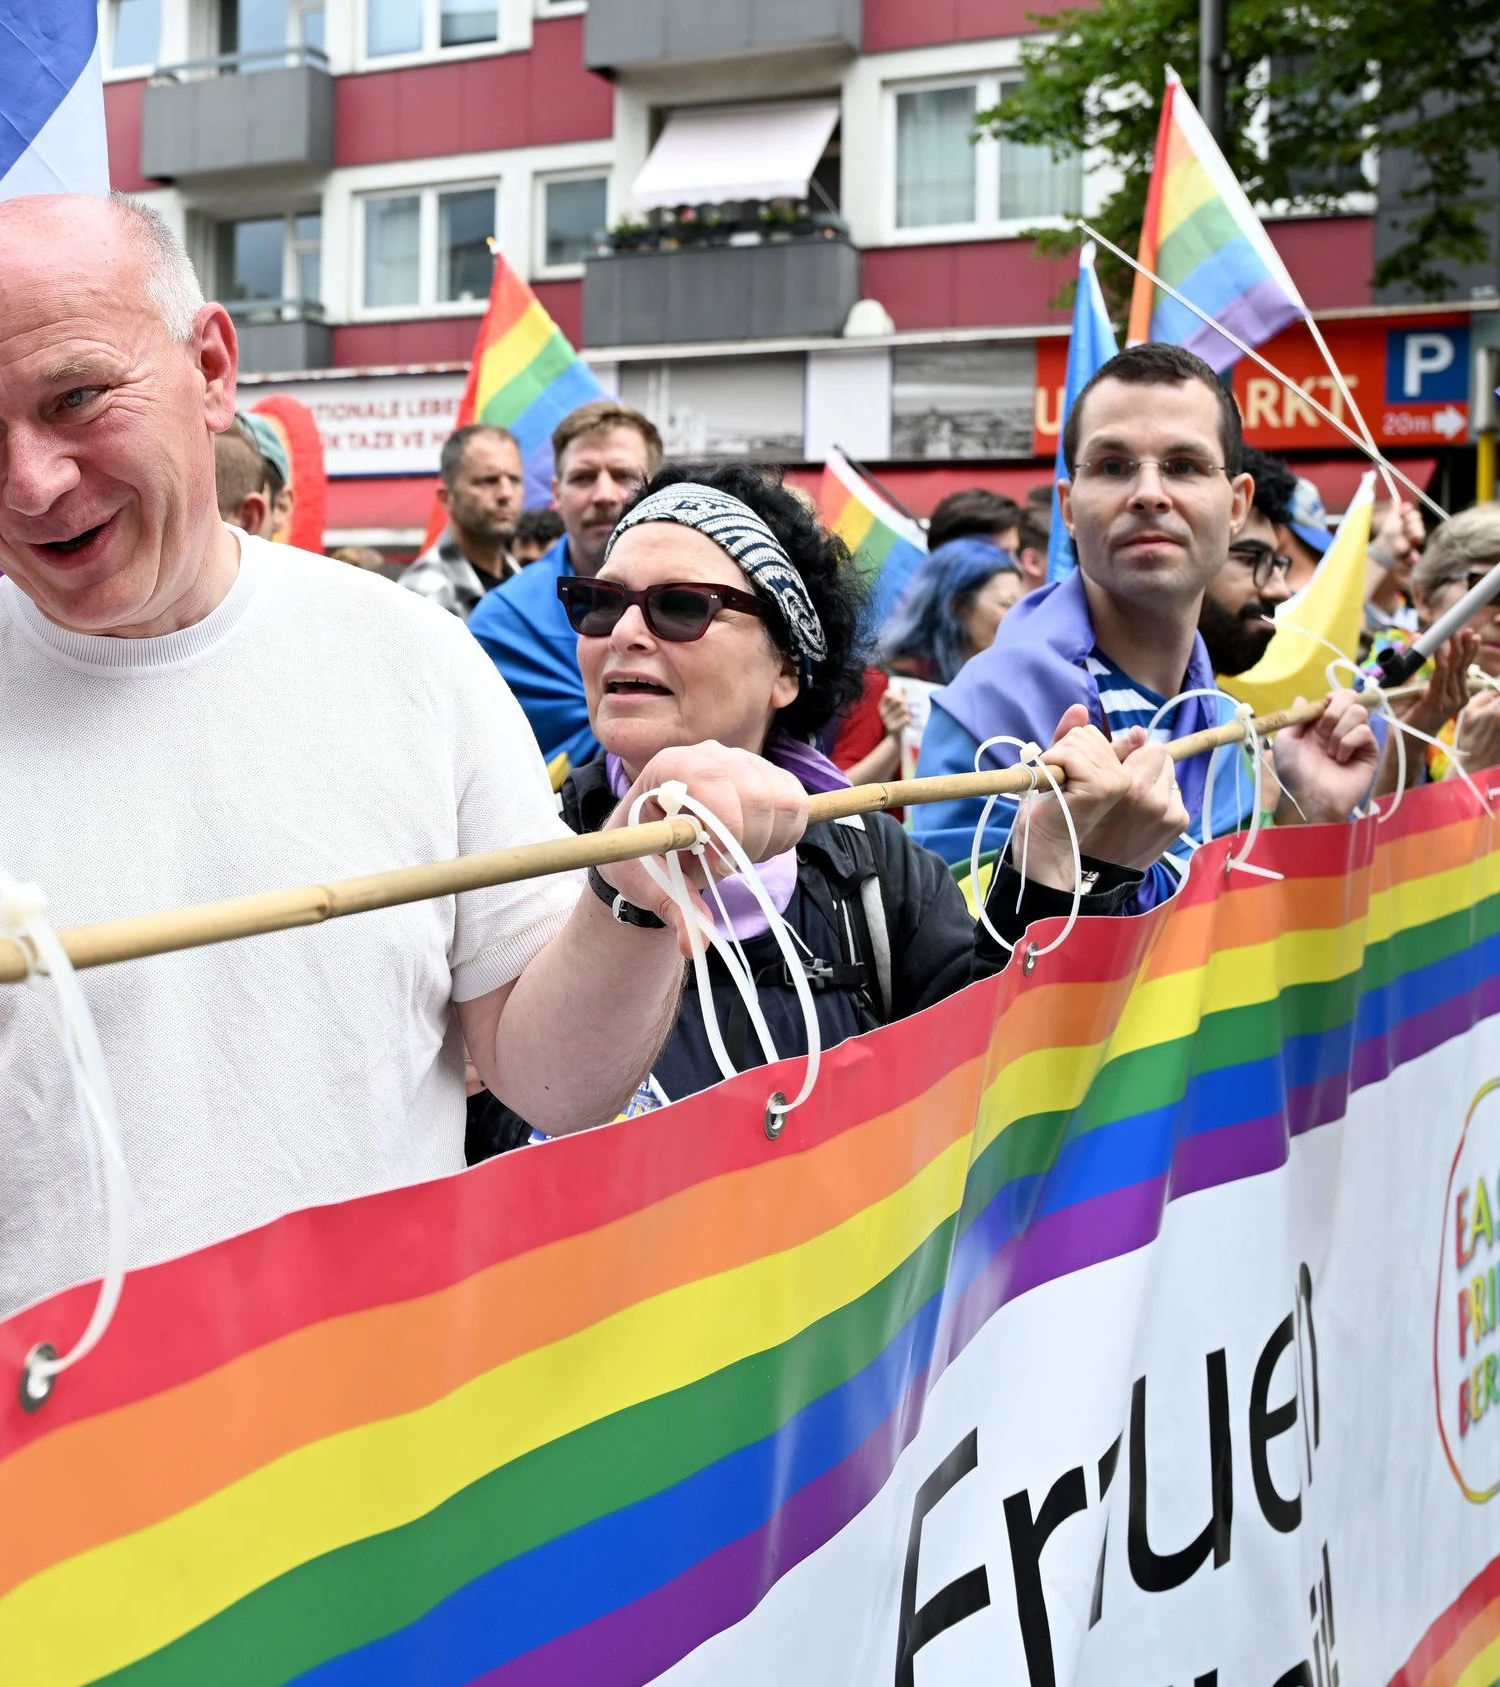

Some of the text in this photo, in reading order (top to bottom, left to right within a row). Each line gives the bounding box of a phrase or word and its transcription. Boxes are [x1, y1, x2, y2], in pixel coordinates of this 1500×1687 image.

[1404, 333, 1455, 397] P
[406, 398, 457, 418] LEBE
[1234, 374, 1359, 430] RKT
[1382, 411, 1430, 436] 20m
[1455, 1170, 1500, 1271] EA
[1457, 1262, 1500, 1360] PRI
[1458, 1352, 1500, 1438] BER
